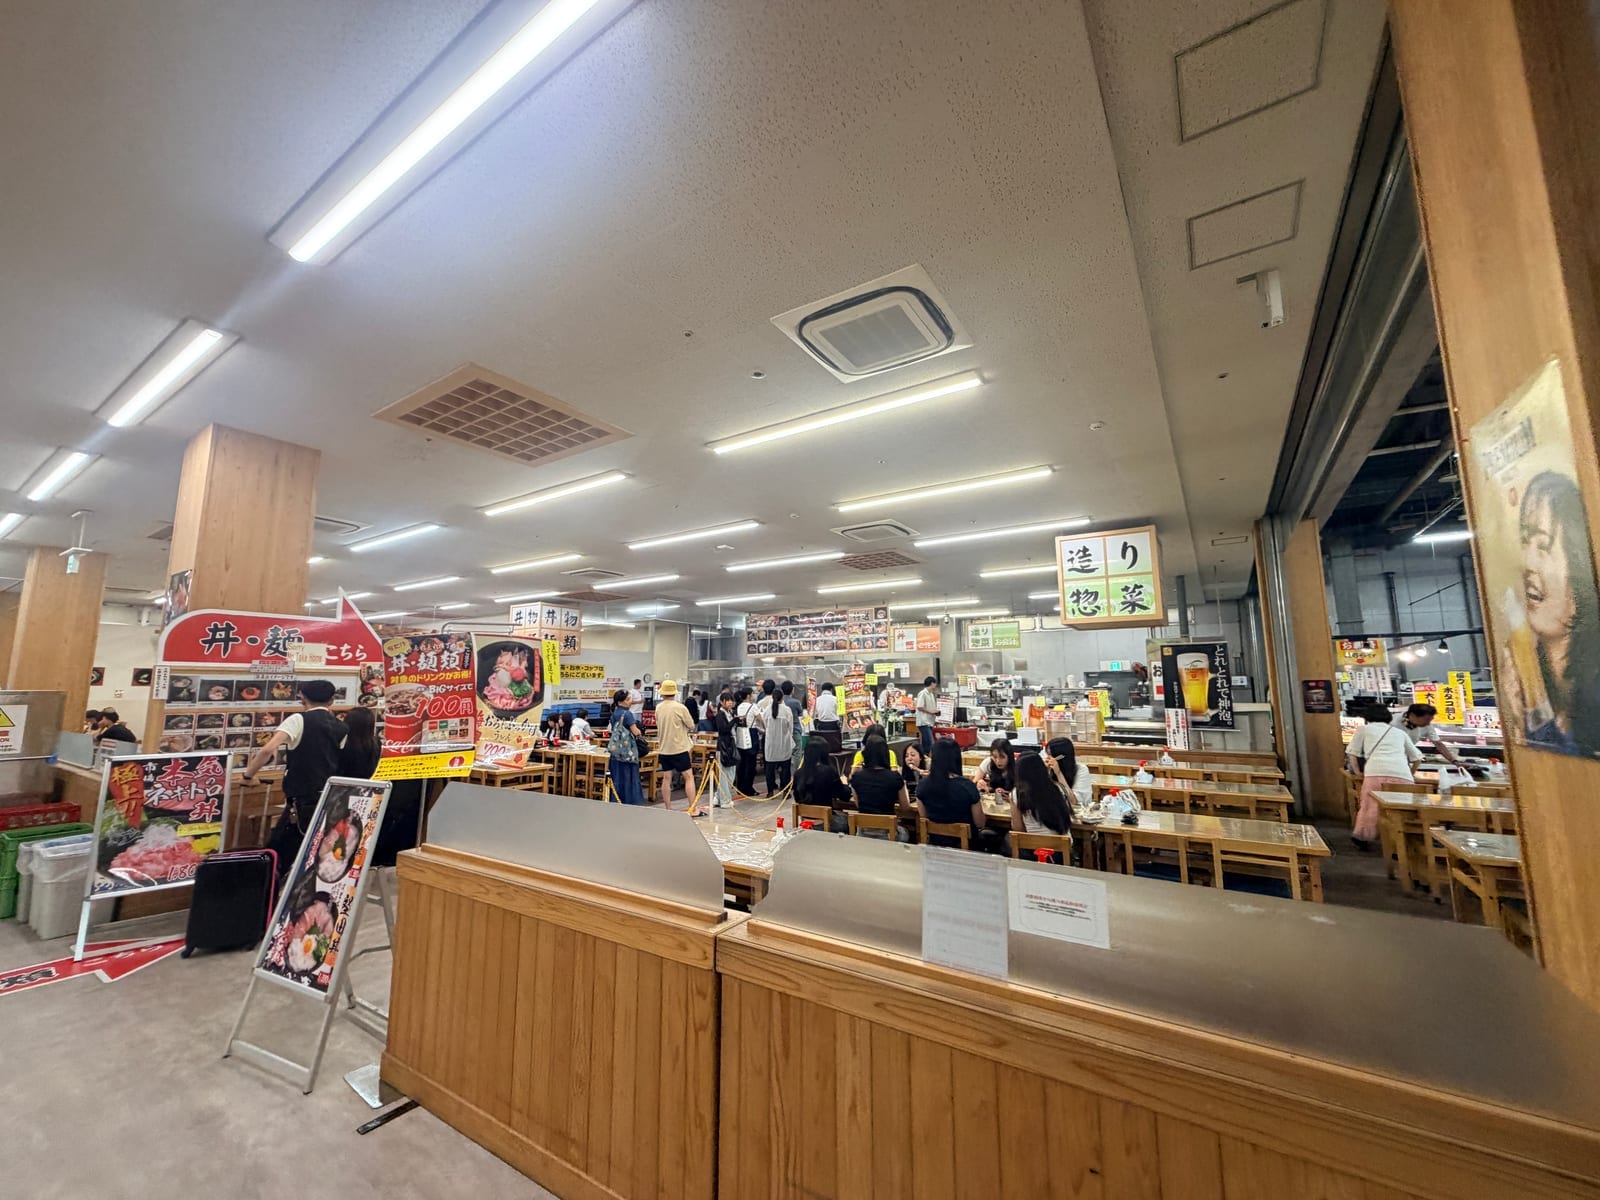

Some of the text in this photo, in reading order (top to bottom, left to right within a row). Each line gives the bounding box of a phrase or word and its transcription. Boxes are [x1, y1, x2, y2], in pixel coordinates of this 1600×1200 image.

[1067, 541, 1138, 573] 造り
[1069, 584, 1150, 617] 惣菜
[514, 608, 539, 624] 丼物
[545, 608, 578, 627] 丼物
[415, 694, 474, 719] 100円
